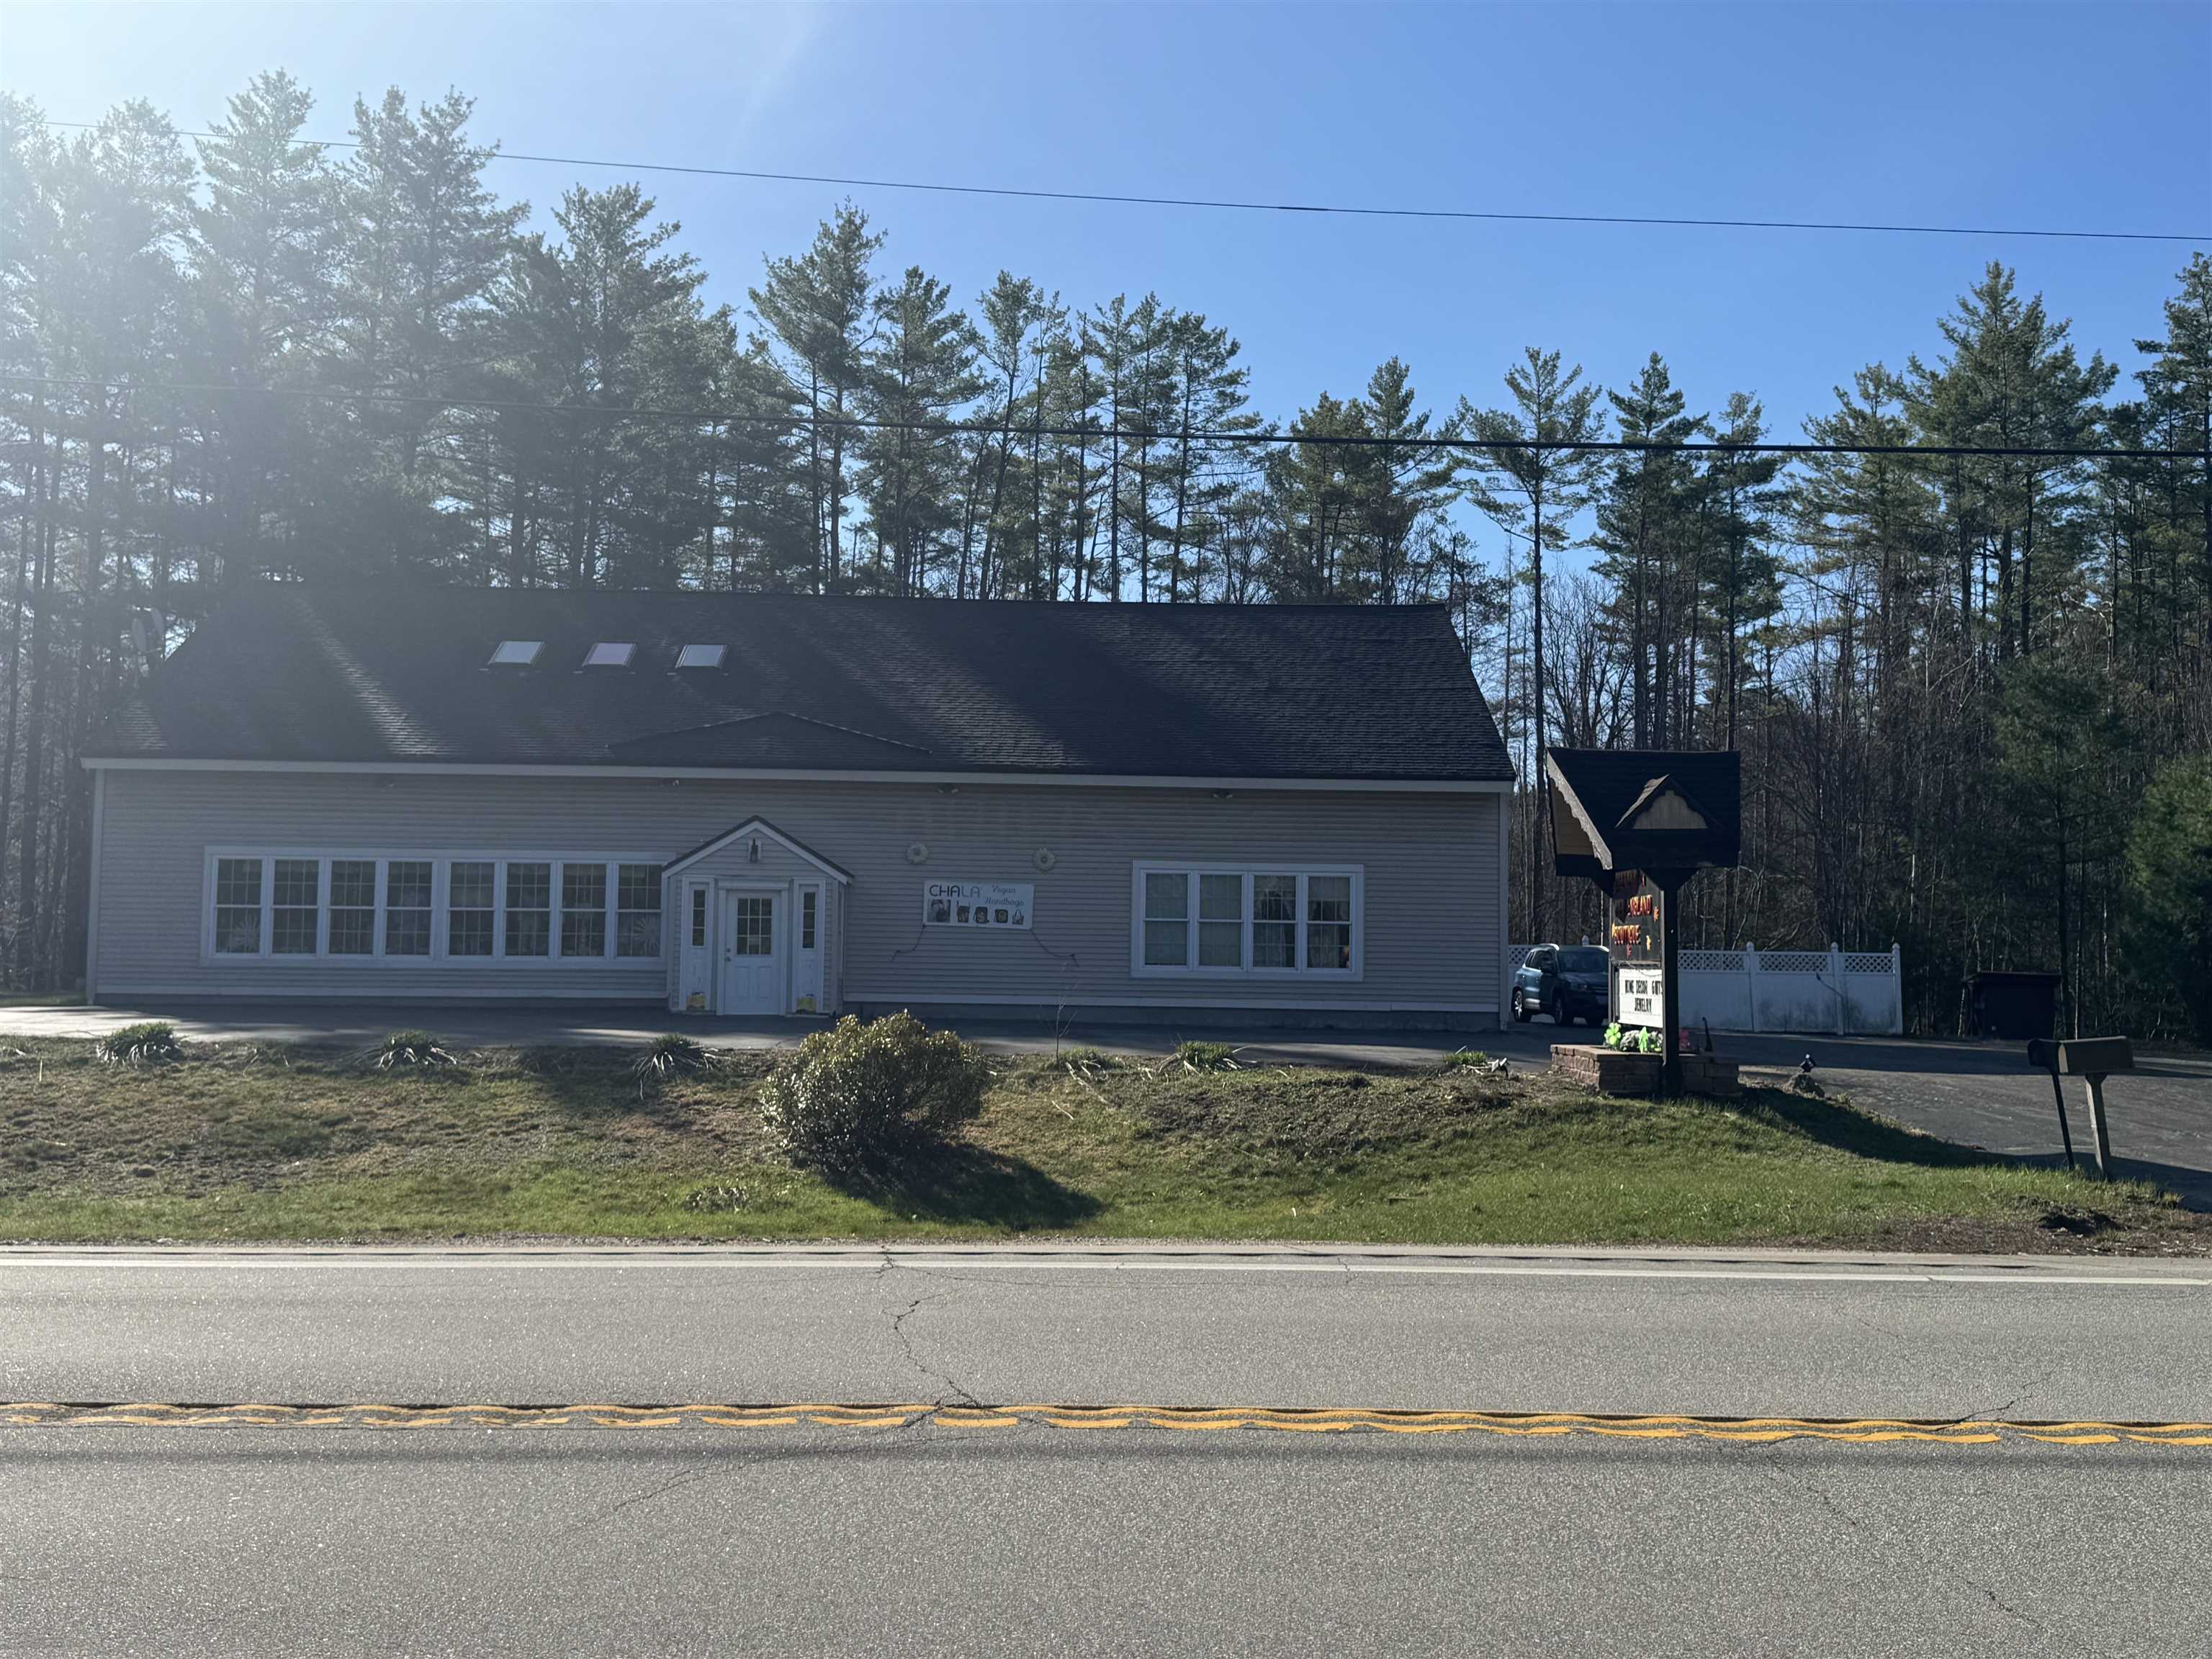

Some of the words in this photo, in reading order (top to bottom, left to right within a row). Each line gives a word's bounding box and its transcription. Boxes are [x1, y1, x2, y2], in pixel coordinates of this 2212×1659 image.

[929, 884, 980, 898] CHALA
[992, 885, 1016, 895] Vegan
[985, 897, 1025, 907] Handbags
[1636, 980, 1647, 995] DECOR
[1635, 997, 1653, 1013] JEWELRY
